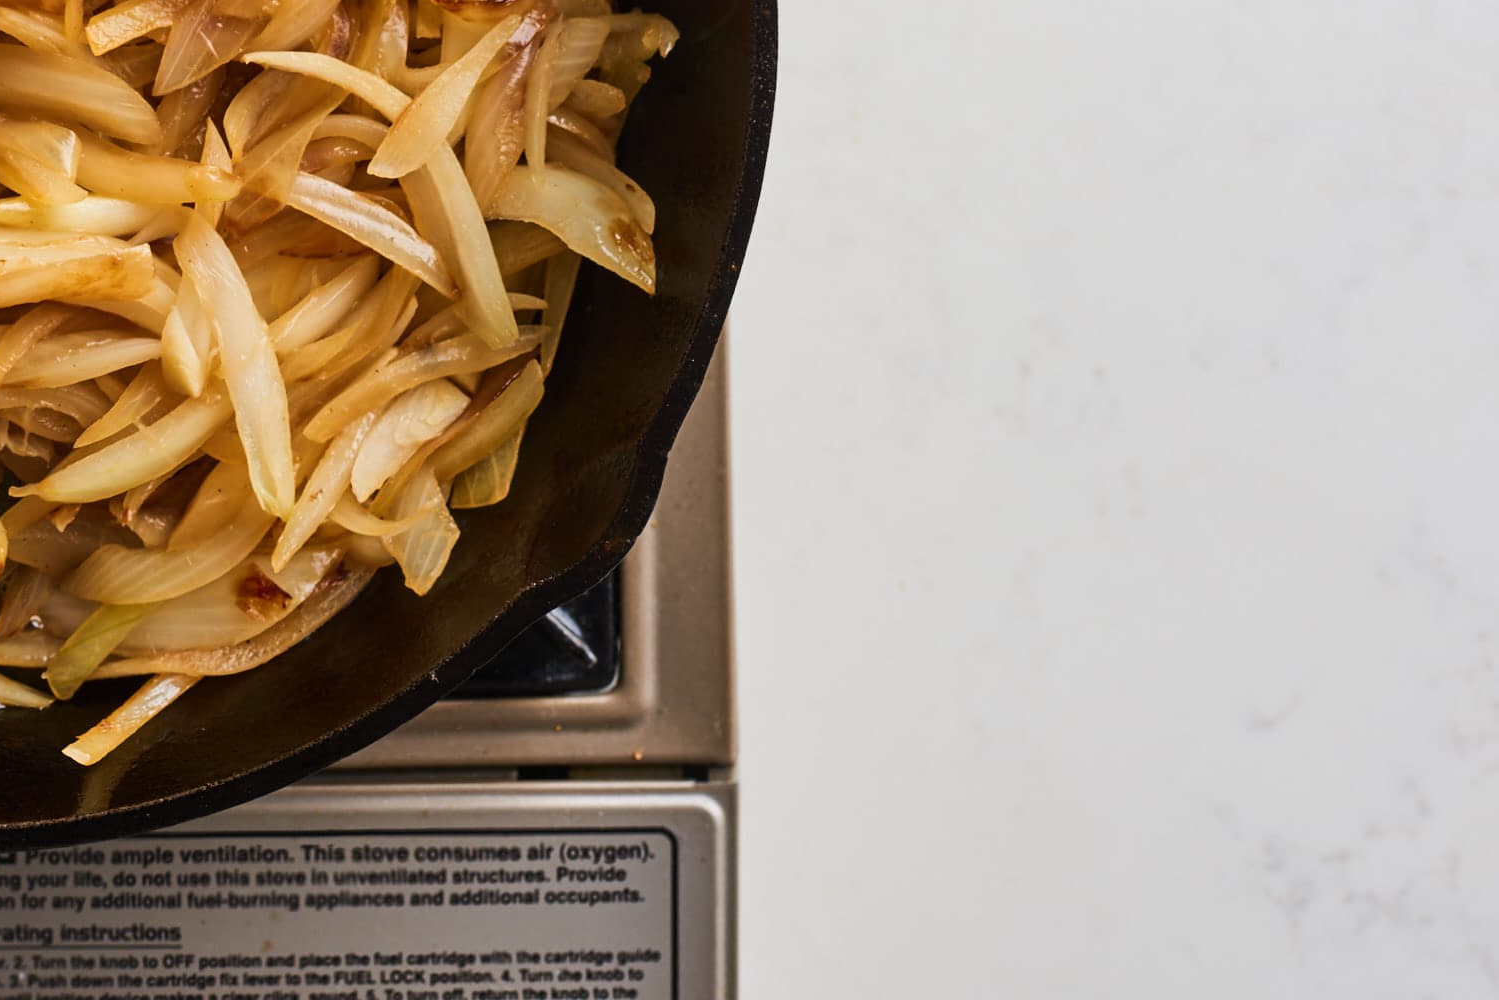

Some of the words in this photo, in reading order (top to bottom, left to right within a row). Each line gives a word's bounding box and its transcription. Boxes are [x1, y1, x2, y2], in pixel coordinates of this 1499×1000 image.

[25, 848, 105, 865] Provide
[111, 846, 174, 868] ample
[180, 846, 295, 863] ventilation.
[300, 844, 345, 862] This
[351, 845, 409, 863] stove
[414, 846, 521, 862] consumes
[527, 843, 553, 861] air
[559, 841, 654, 864] (oxygen).
[27, 874, 68, 891] your
[73, 872, 107, 888] life,
[113, 872, 136, 887] do
[142, 872, 171, 887] not
[177, 872, 210, 886] use
[215, 870, 250, 886] this
[256, 870, 306, 886] stove
[311, 869, 328, 885] in
[333, 868, 446, 885] unventilated
[452, 868, 550, 884] structures.
[556, 867, 627, 882] Provide
[21, 893, 47, 909] for
[52, 895, 86, 913] any
[91, 892, 181, 909] additional
[187, 892, 300, 910] fuel-burning
[305, 891, 404, 910] appliances
[410, 891, 444, 906] and
[449, 889, 539, 905] additional
[544, 887, 645, 907] occupants.
[60, 923, 181, 941] instructions
[13, 956, 26, 969] 2.
[32, 955, 66, 968] Turn
[71, 956, 95, 968] the
[99, 955, 139, 968] knob
[143, 955, 158, 968] to
[162, 955, 195, 968] OFF
[199, 955, 262, 970] position
[266, 955, 296, 967] and
[299, 954, 341, 969] place
[345, 953, 370, 966] the
[373, 952, 403, 966] fuel
[406, 952, 476, 967] cartridge
[480, 951, 512, 964] with
[516, 951, 541, 963] the
[544, 950, 613, 966] cartridge
[617, 948, 661, 965] guide
[27, 974, 66, 987] Push
[71, 974, 114, 987] down
[118, 974, 143, 987] the
[146, 973, 215, 989] cartridge
[220, 972, 238, 985] fix
[243, 972, 282, 985] lever
[285, 973, 301, 985] to
[305, 972, 330, 985] the
[334, 971, 375, 985] FUEL
[380, 970, 424, 984] LOCK
[430, 970, 495, 985] position.
[501, 969, 514, 982] 4.
[519, 968, 553, 982] Turn
[558, 969, 582, 981] the
[586, 968, 625, 981] knob
[628, 968, 644, 981] to
[551, 987, 589, 1000] knob
[593, 987, 609, 1000] to
[613, 986, 638, 999] the
